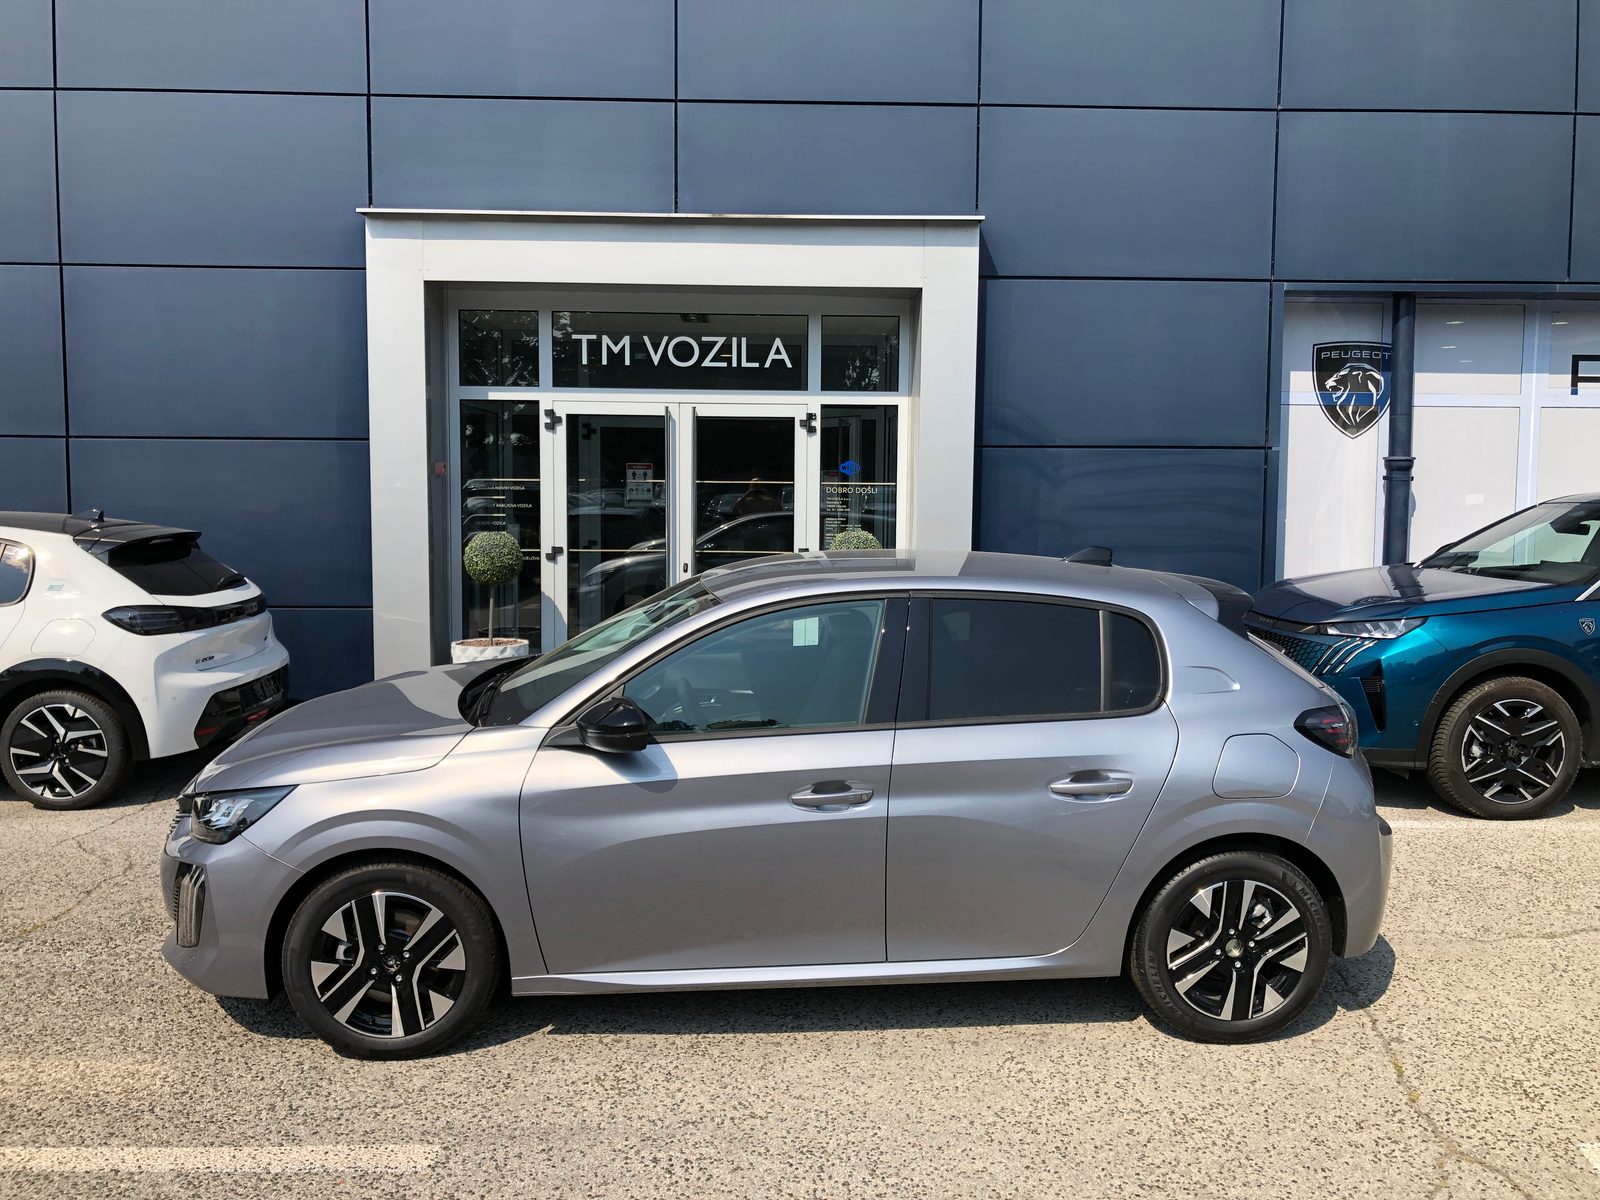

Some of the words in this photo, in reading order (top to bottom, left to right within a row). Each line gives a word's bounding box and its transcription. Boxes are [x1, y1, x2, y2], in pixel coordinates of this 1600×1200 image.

[571, 334, 631, 366] TM
[643, 336, 793, 368] VOZILA
[1321, 350, 1392, 360] PEUGEOT
[826, 486, 854, 494] DOBRO
[855, 485, 878, 494] DOŠLI
